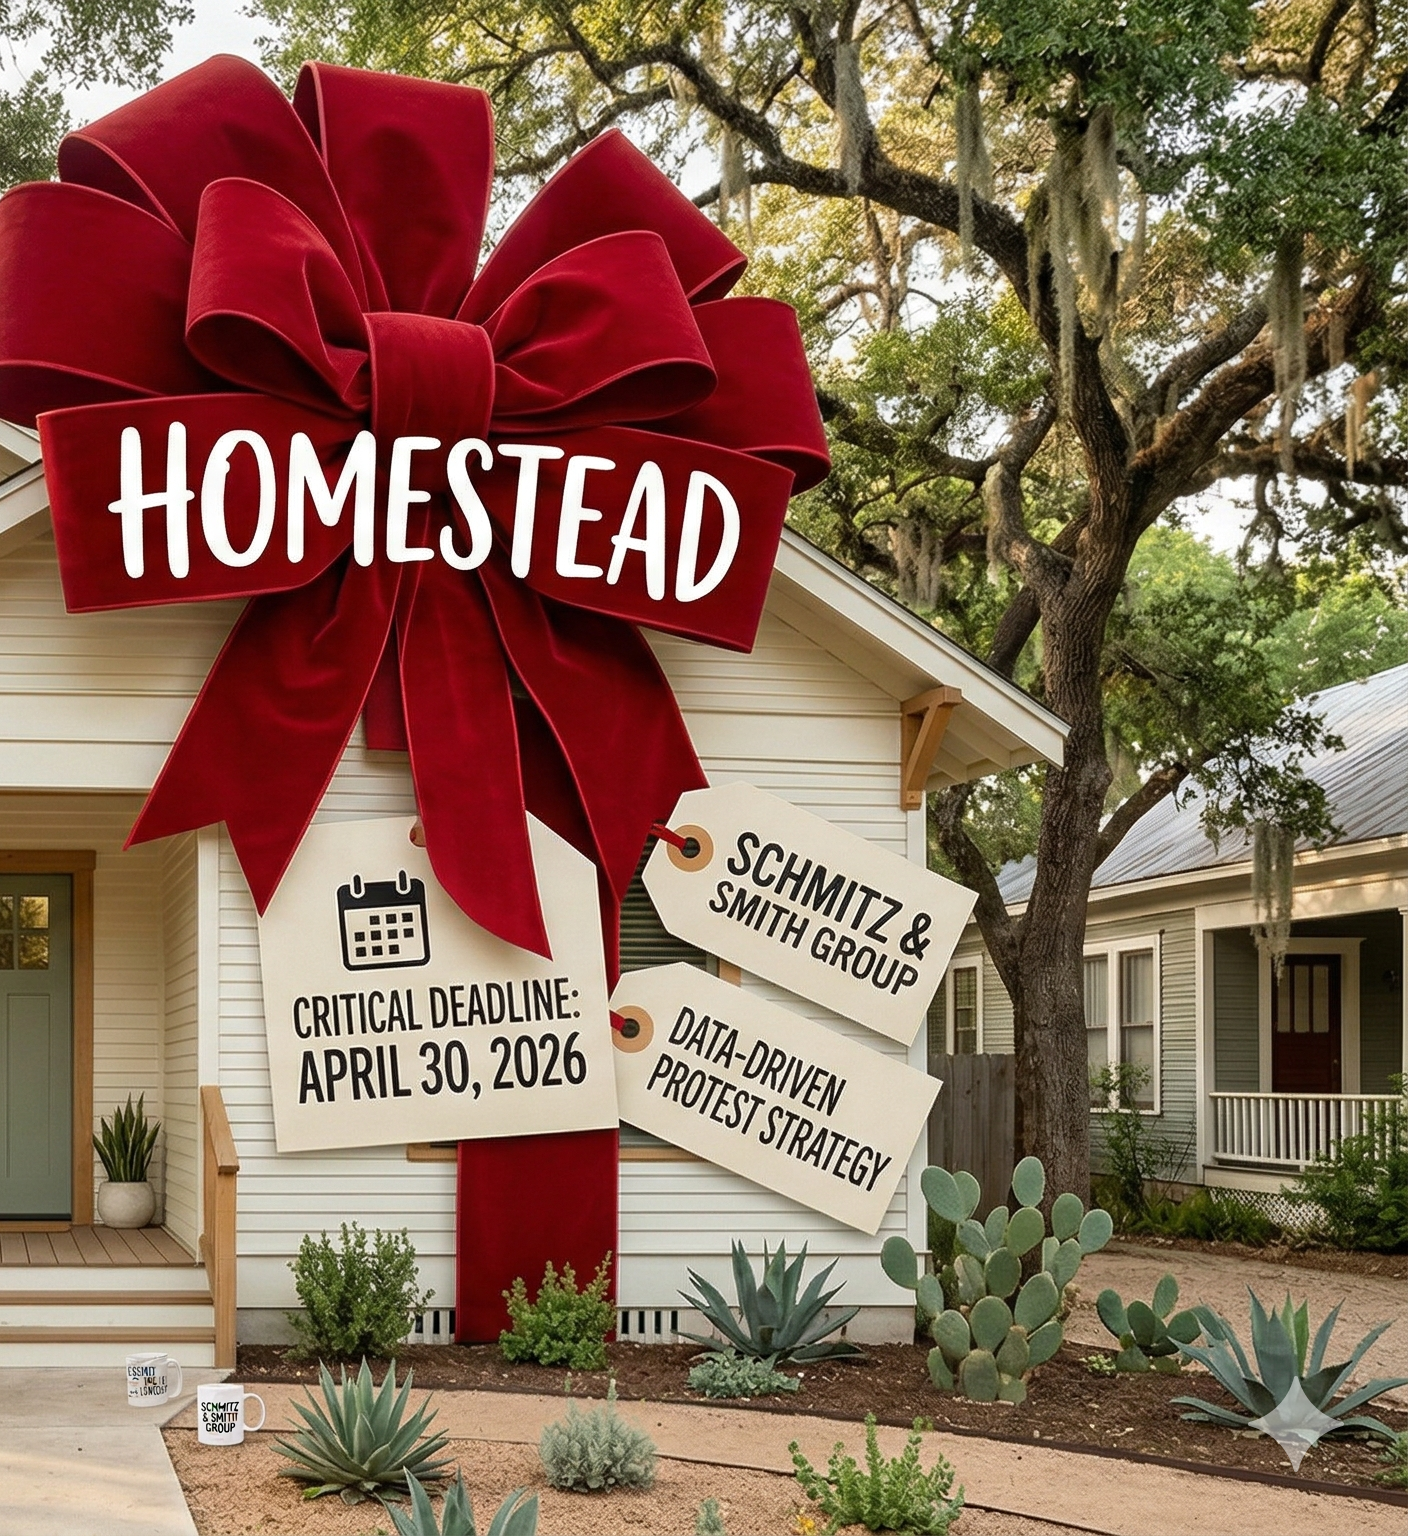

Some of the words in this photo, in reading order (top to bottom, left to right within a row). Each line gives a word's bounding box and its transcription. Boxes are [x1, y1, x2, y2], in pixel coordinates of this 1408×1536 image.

[107, 420, 741, 603] HOMESTEAD
[708, 880, 811, 949] SMITH
[809, 926, 920, 996] GROUP
[726, 831, 904, 945] SCHMITZ
[899, 912, 933, 962] &
[293, 989, 423, 1039] CRITICAL
[431, 978, 582, 1031] DEADLINE:
[668, 1005, 847, 1116] DATA-DRIVEN
[298, 1044, 413, 1105] APRIL
[419, 1040, 482, 1100] 30,
[490, 1031, 588, 1091] 2026
[646, 1053, 767, 1136] PROTEST
[758, 1105, 893, 1193] STRATEGY
[202, 1412, 209, 1423] &
[205, 1422, 236, 1434] GROUP
